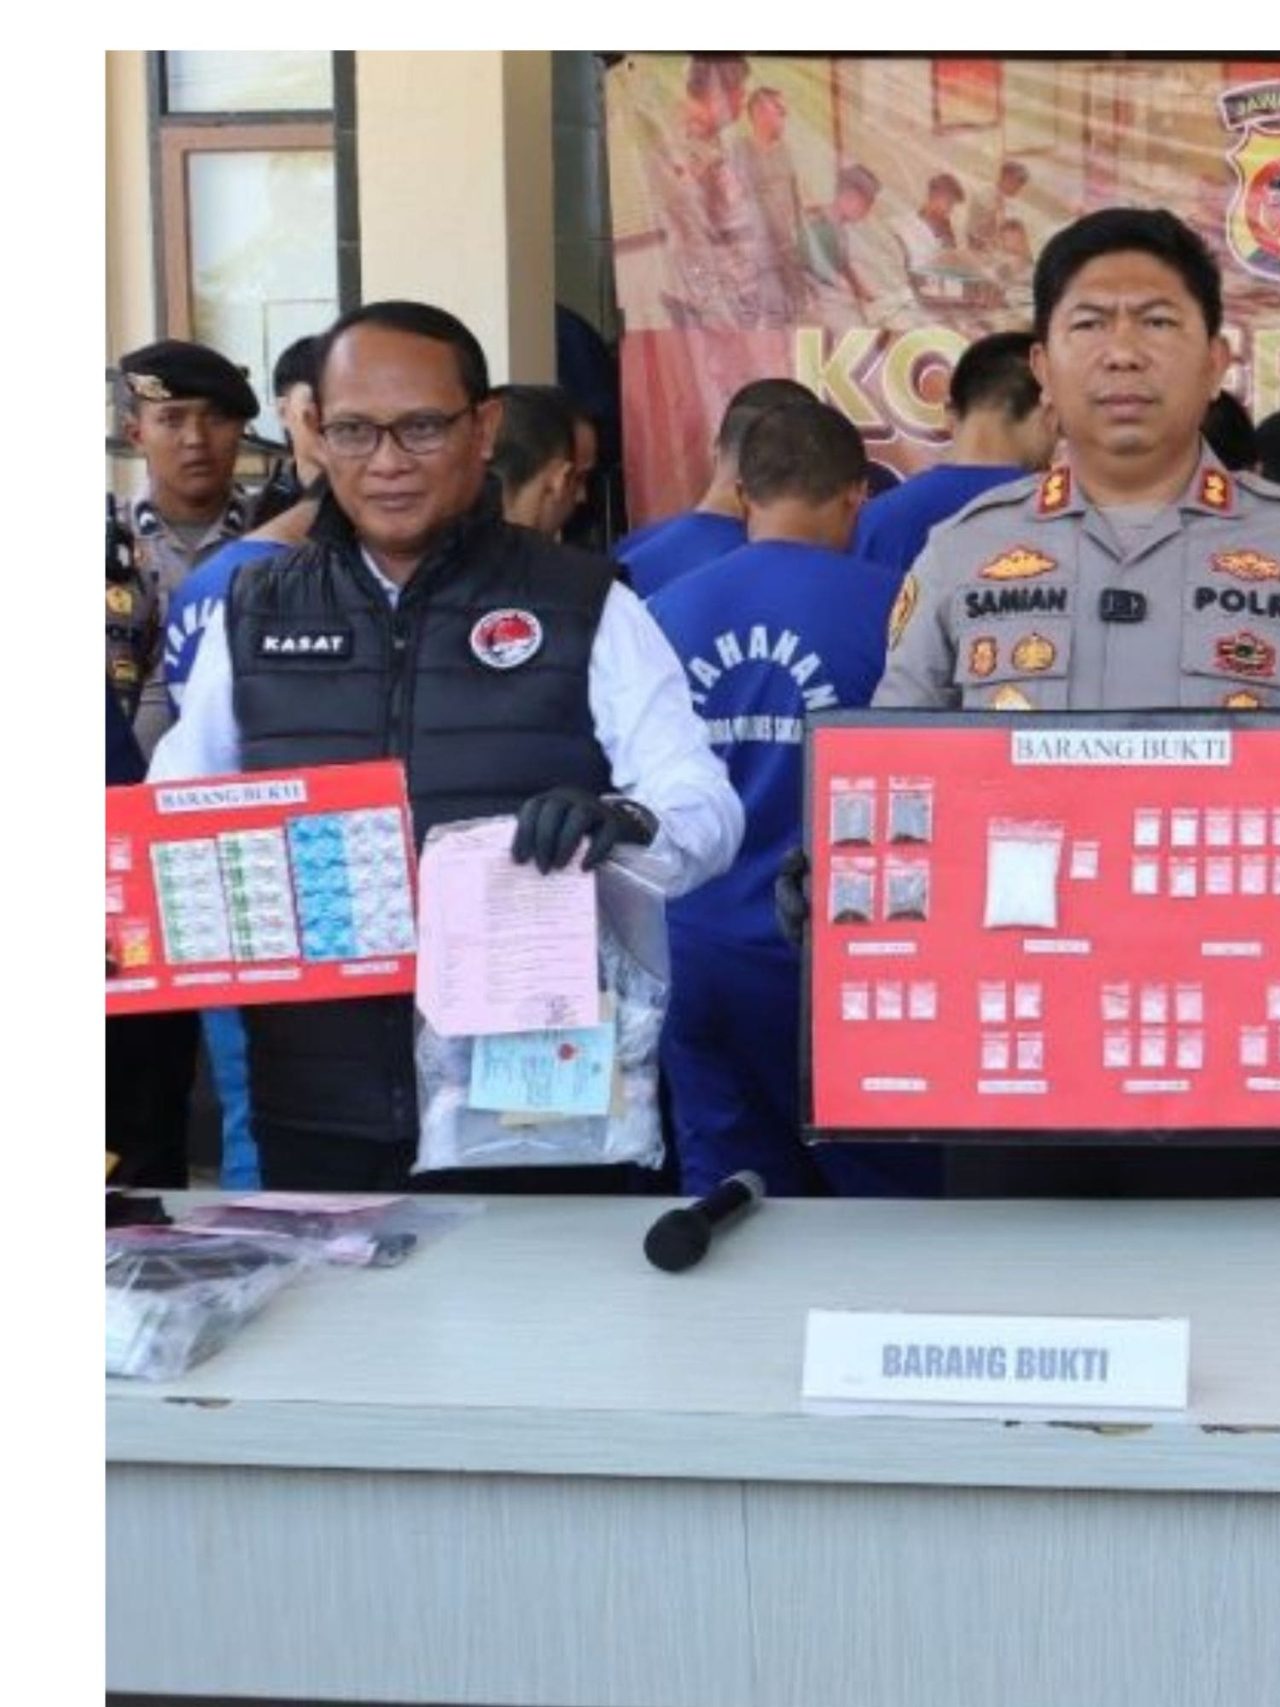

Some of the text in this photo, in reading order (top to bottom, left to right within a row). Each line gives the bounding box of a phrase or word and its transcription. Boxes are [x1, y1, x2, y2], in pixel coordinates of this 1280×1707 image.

[965, 587, 1067, 619] SAMIAN
[262, 634, 344, 654] KASAT
[1016, 735, 1228, 760] BARANG BUKTI
[881, 1343, 1110, 1382] BARANG BUKTI
